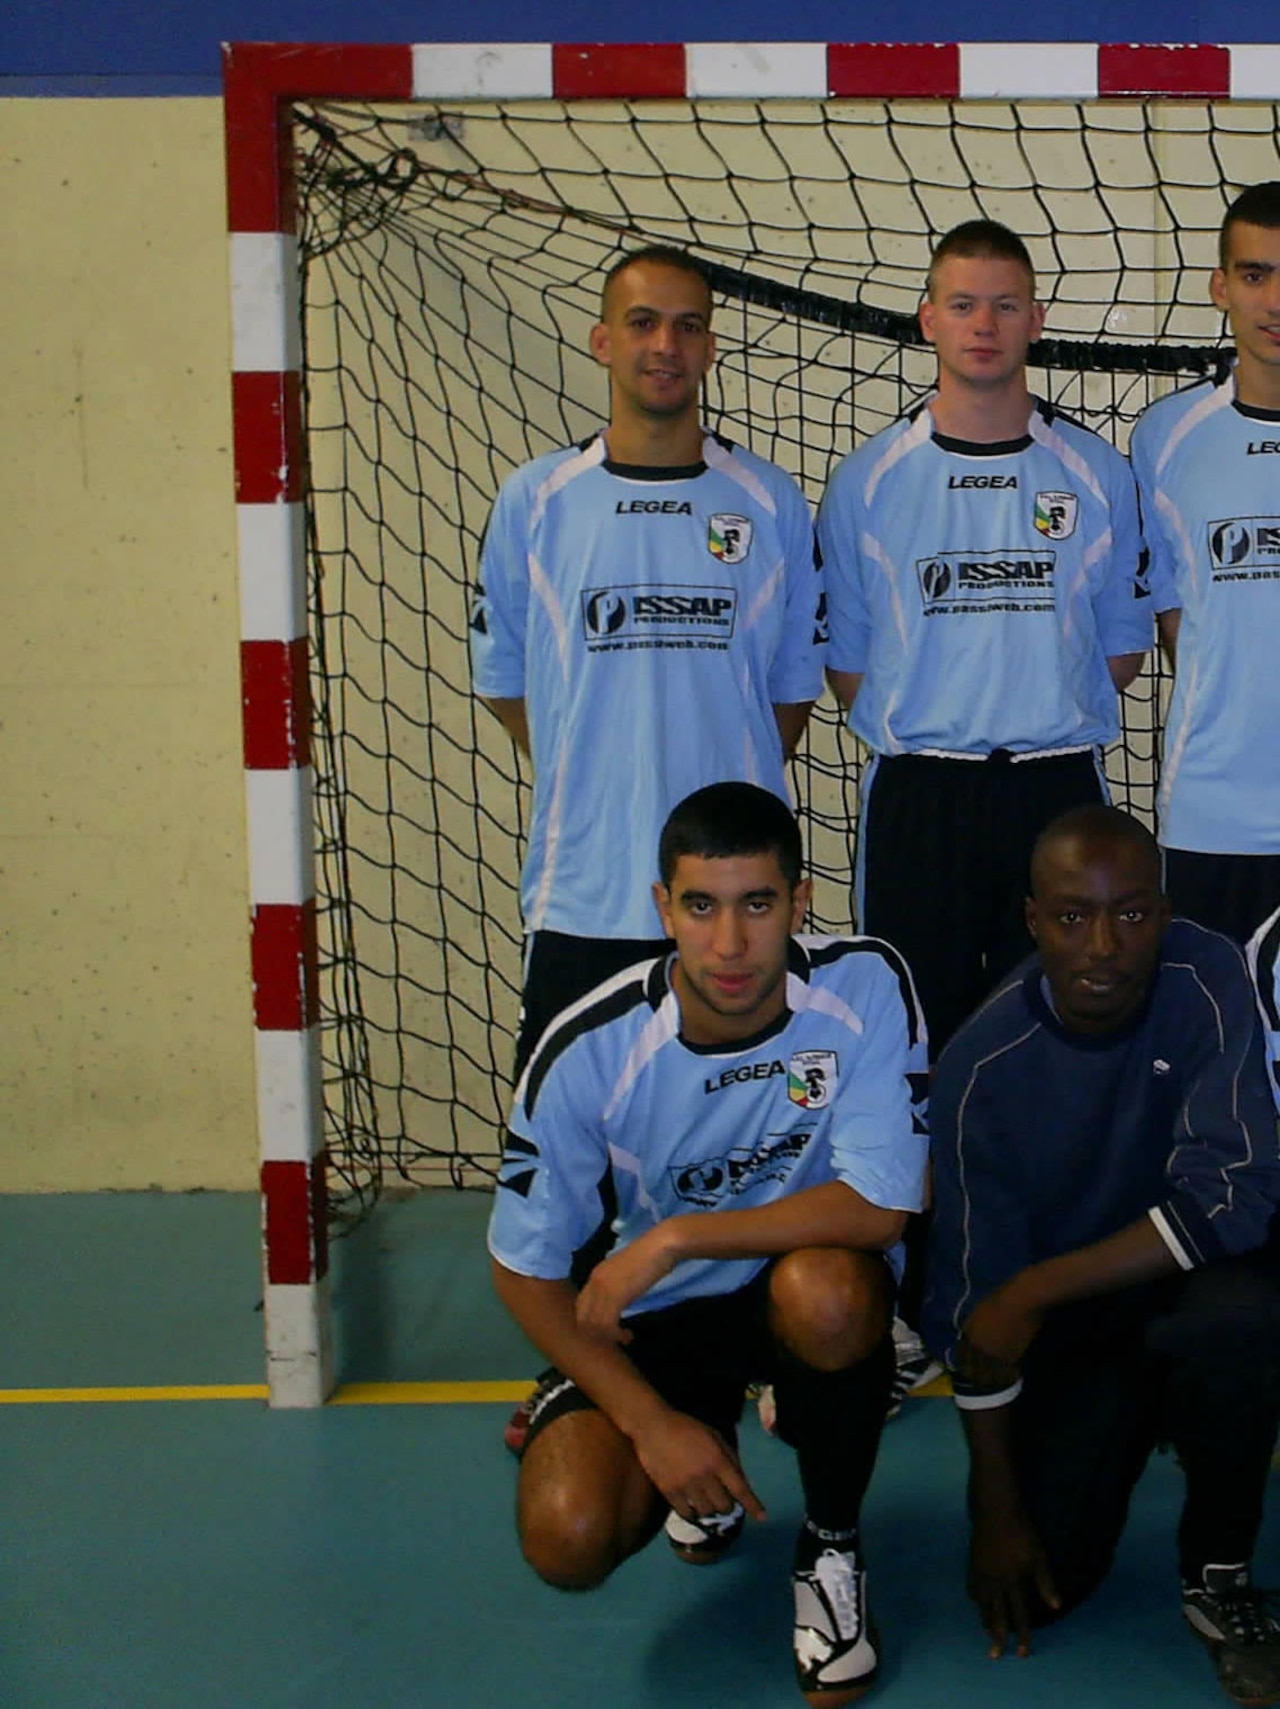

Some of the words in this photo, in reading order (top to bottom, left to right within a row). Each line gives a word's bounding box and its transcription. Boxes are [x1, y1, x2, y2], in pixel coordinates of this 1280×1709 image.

[947, 475, 1019, 490] LEGEA
[615, 500, 692, 515] LEGEA
[957, 560, 1053, 580] ISSAP
[957, 579, 1054, 590] PRODUCTIONS
[633, 595, 733, 616] ISSAP
[704, 1059, 786, 1095] LEGEA
